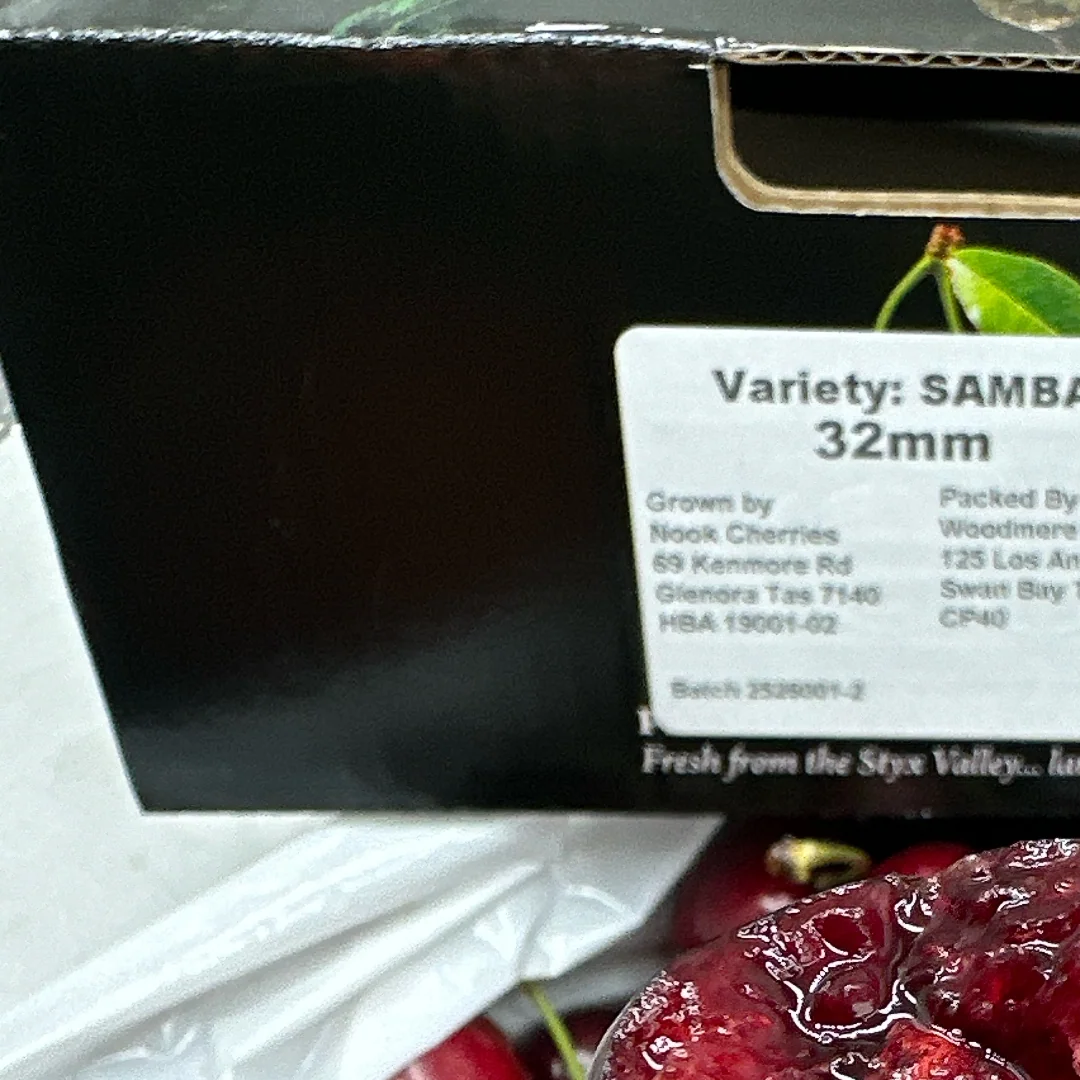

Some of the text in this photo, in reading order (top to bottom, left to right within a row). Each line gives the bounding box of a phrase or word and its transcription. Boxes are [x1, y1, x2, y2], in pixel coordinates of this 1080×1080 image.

[711, 368, 905, 415] Variety:
[813, 418, 993, 462] 32mm
[646, 490, 775, 518] Grown by
[939, 487, 1080, 514] Packed By
[650, 521, 840, 545] Nook Cherries
[939, 517, 1079, 541] Woodmere
[691, 553, 810, 575] Kenmore
[815, 553, 854, 575] Rd
[941, 550, 986, 570] 125
[992, 550, 1041, 571] Los
[656, 581, 759, 604] Glenora
[764, 582, 813, 604] Tas
[642, 743, 722, 775] Fresh
[720, 742, 798, 784] from
[805, 743, 850, 776] the
[858, 745, 926, 784] Styx
